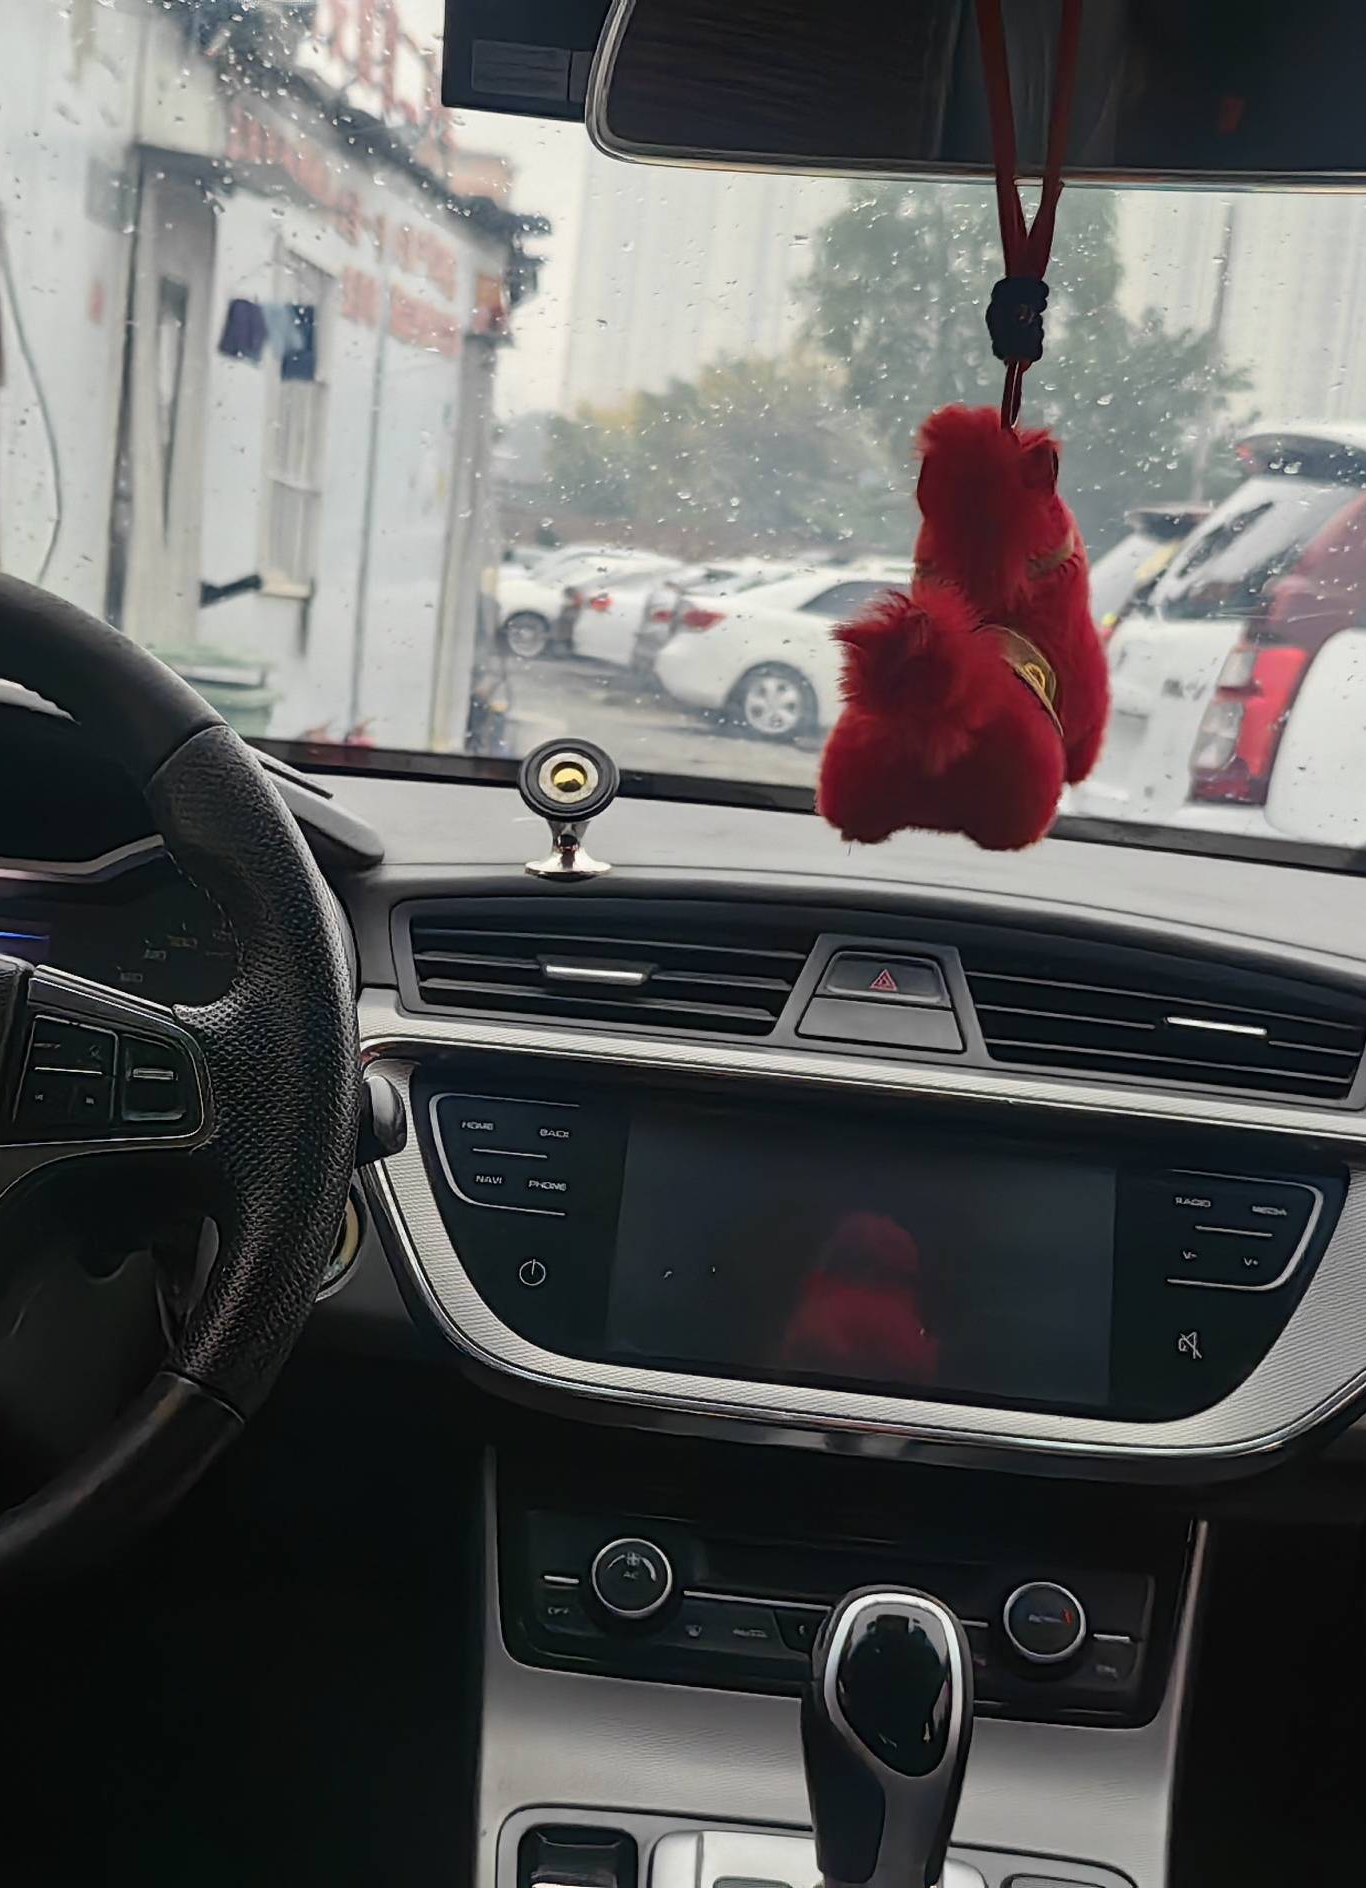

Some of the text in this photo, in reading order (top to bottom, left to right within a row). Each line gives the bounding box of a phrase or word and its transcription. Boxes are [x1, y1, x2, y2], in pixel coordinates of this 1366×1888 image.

[461, 1121, 494, 1131] HOME
[475, 1175, 503, 1184] NAVI
[528, 1180, 567, 1191] PHONE
[1175, 1197, 1211, 1208] RADIO
